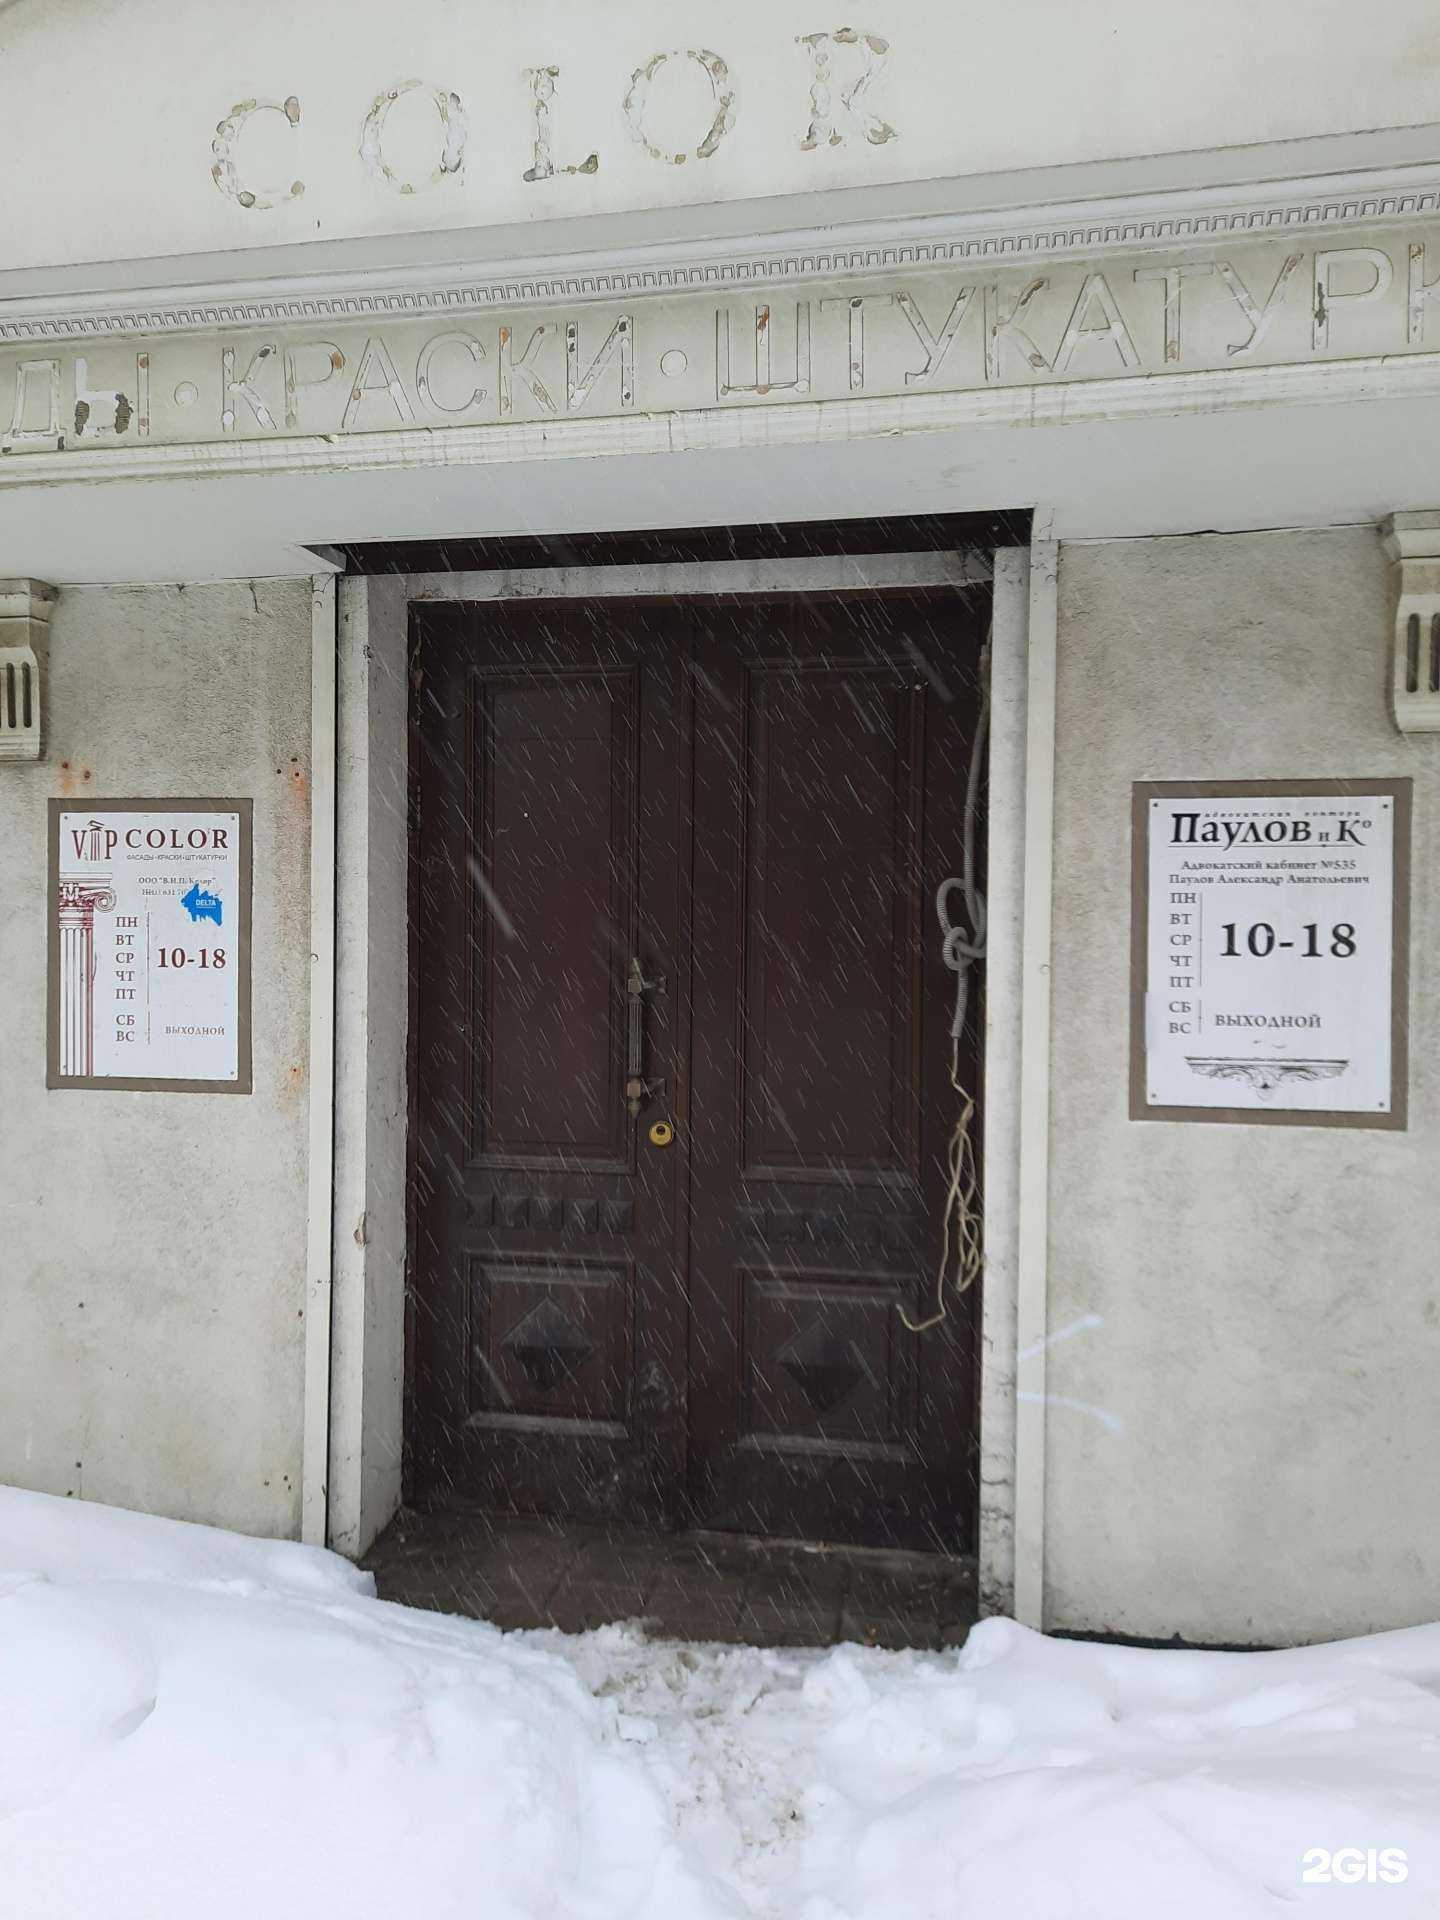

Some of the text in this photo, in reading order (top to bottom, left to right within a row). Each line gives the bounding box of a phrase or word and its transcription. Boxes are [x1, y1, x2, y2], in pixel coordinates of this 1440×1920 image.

[210, 27, 898, 210] COLOR
[222, 314, 635, 431] КРАСКИ
[1170, 813, 1311, 852] Паулов
[71, 819, 228, 861] VIP COLOR
[1182, 860, 1357, 870] Адвокатский кабинет №535
[1169, 874, 1370, 886] Паулов Александр Анатольевич
[1170, 893, 1197, 904] ПН
[116, 916, 138, 928] ПН
[1170, 914, 1192, 925] ВТ
[116, 934, 134, 946] ВТ
[1170, 935, 1192, 946] СР
[1220, 922, 1357, 958] 10-18
[116, 952, 134, 964] СР
[157, 948, 227, 969] 10-18
[1170, 956, 1193, 967] ЧТ
[116, 970, 135, 982] ЧТ
[1170, 976, 1194, 988] ПТ
[116, 988, 136, 1000] ПТ
[1169, 1001, 1192, 1013] СБ
[116, 1014, 135, 1026] СБ
[1215, 1013, 1322, 1029] ВЫХОДНОЙ
[165, 1025, 226, 1036] ВЫХОДНОЙ
[1169, 1022, 1191, 1034] ВС
[116, 1030, 135, 1042] ВС
